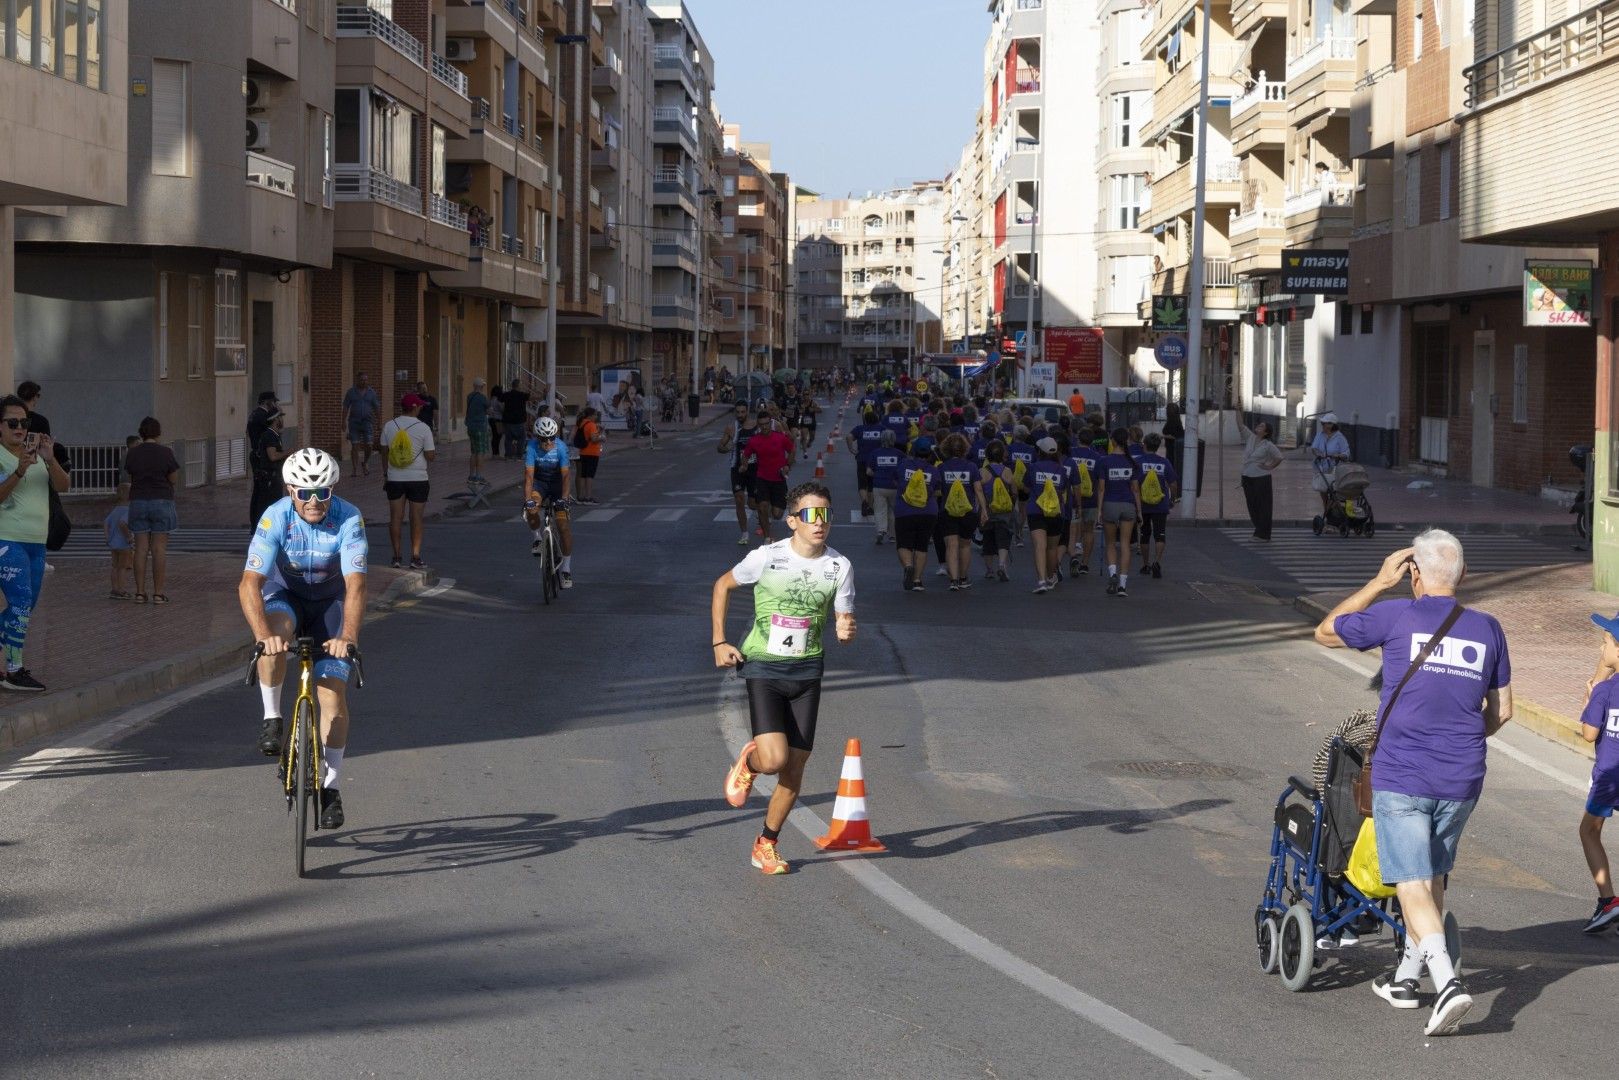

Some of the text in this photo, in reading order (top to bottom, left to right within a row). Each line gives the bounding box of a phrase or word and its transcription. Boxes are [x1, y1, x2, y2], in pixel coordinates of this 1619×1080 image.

[1302, 256, 1348, 269] masy
[1286, 277, 1347, 288] SUPERMER
[782, 635, 794, 648] 4
[1423, 664, 1446, 675] Grupo
[1447, 667, 1483, 681] Inmobiliario
